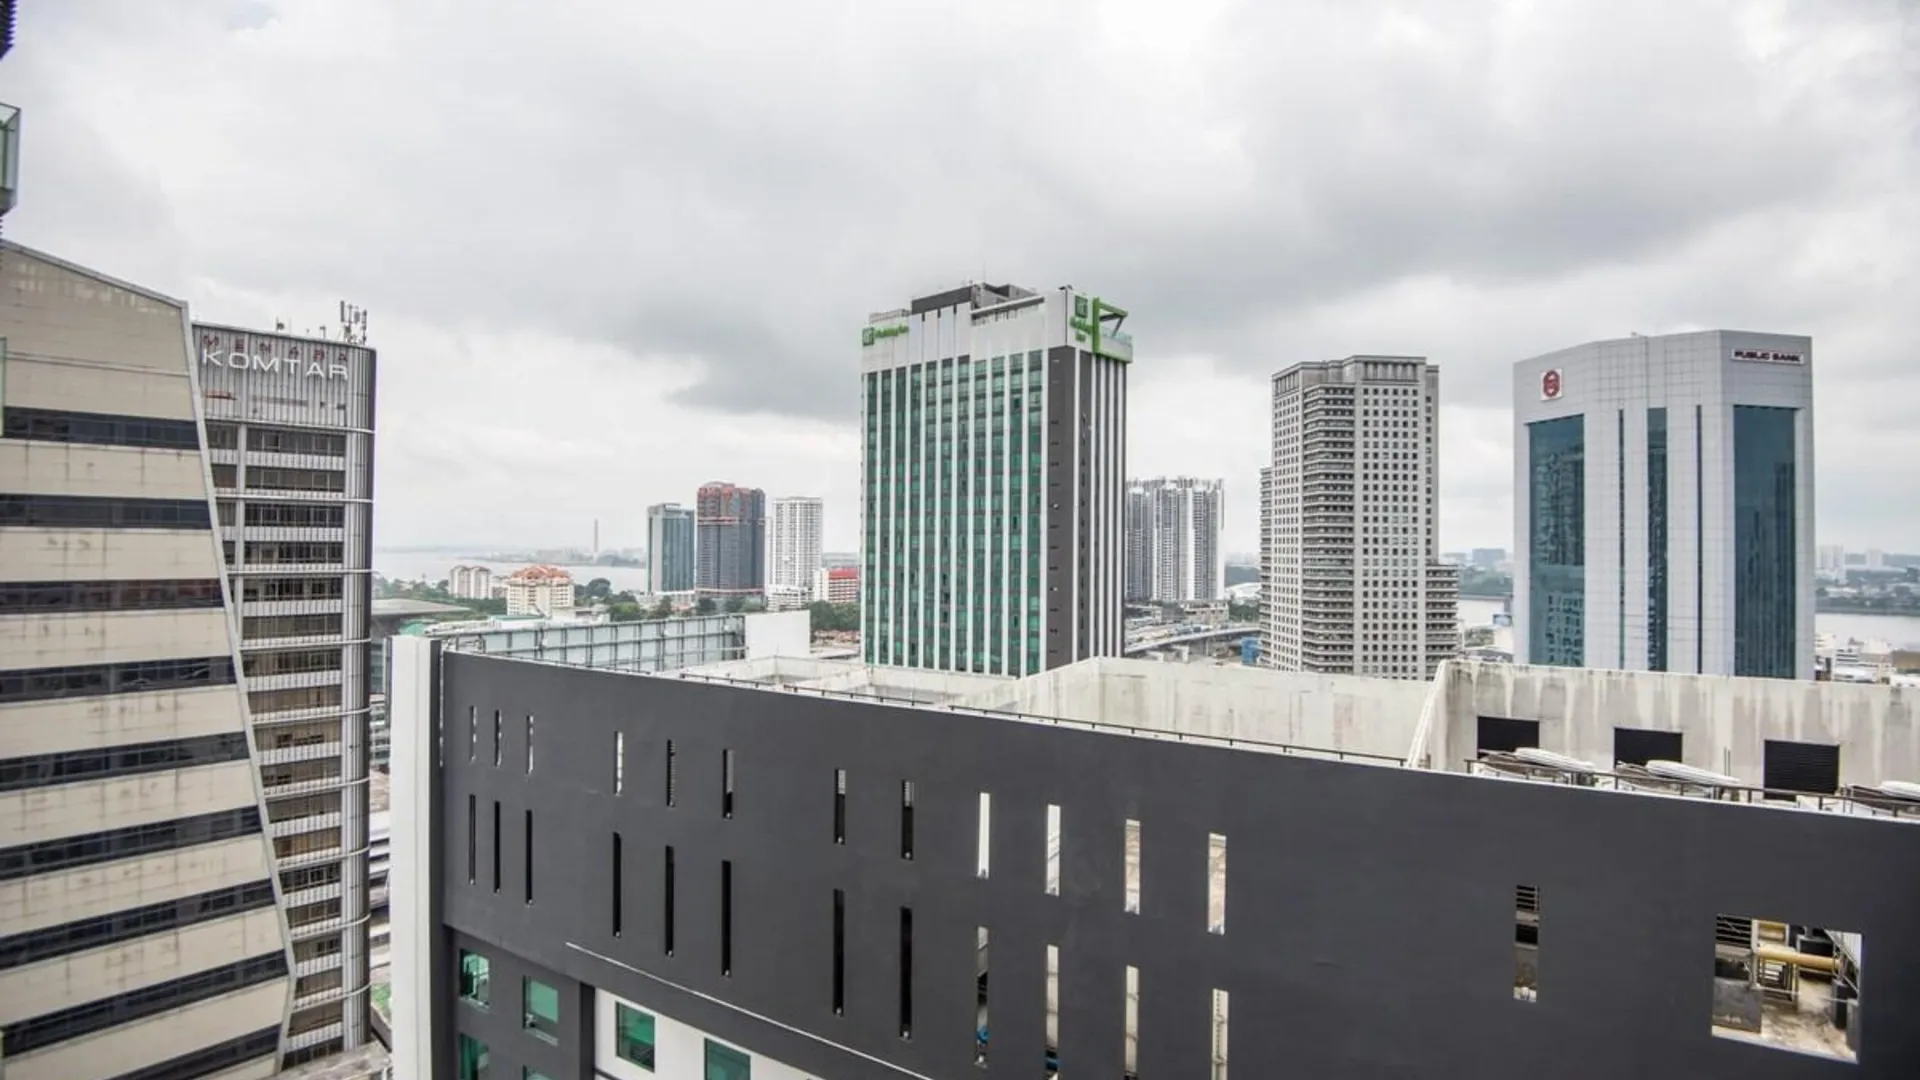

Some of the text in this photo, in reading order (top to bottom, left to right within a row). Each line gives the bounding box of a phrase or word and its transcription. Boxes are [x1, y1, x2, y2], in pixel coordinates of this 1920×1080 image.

[202, 348, 348, 380] KOMTAR
[1735, 351, 1800, 361] PUBLIC BANK
